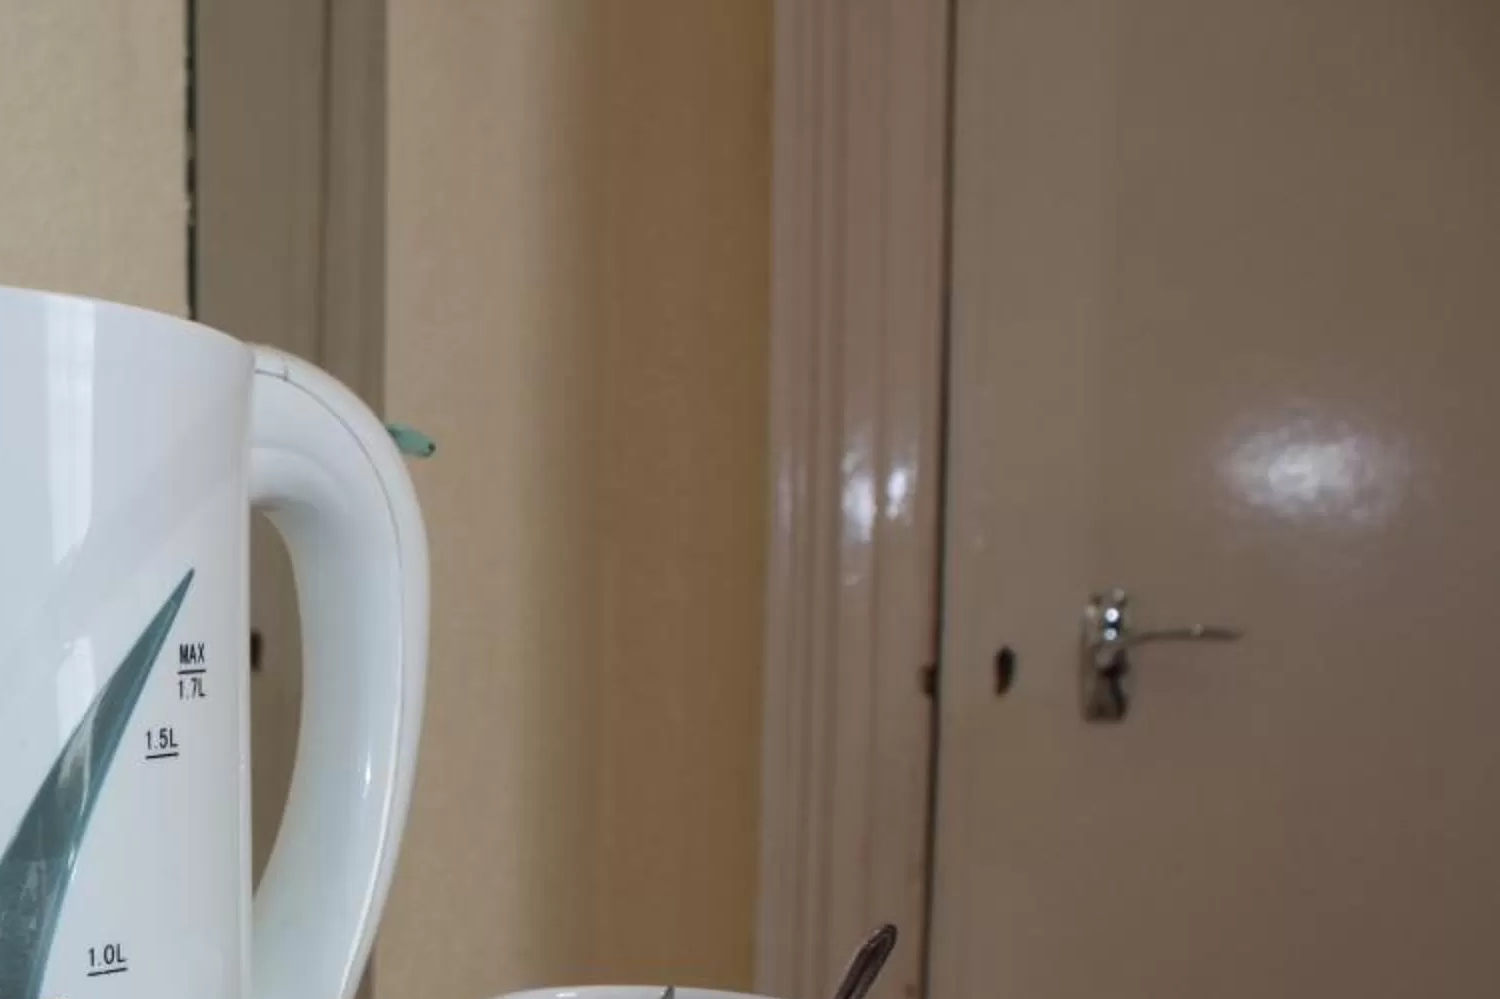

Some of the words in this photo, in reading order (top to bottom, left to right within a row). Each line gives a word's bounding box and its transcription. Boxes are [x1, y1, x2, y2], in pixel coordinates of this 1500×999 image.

[179, 644, 205, 665] MAX
[179, 677, 205, 699] 1.7L
[146, 728, 179, 750] 1.5L
[87, 944, 127, 967] 1.0L
